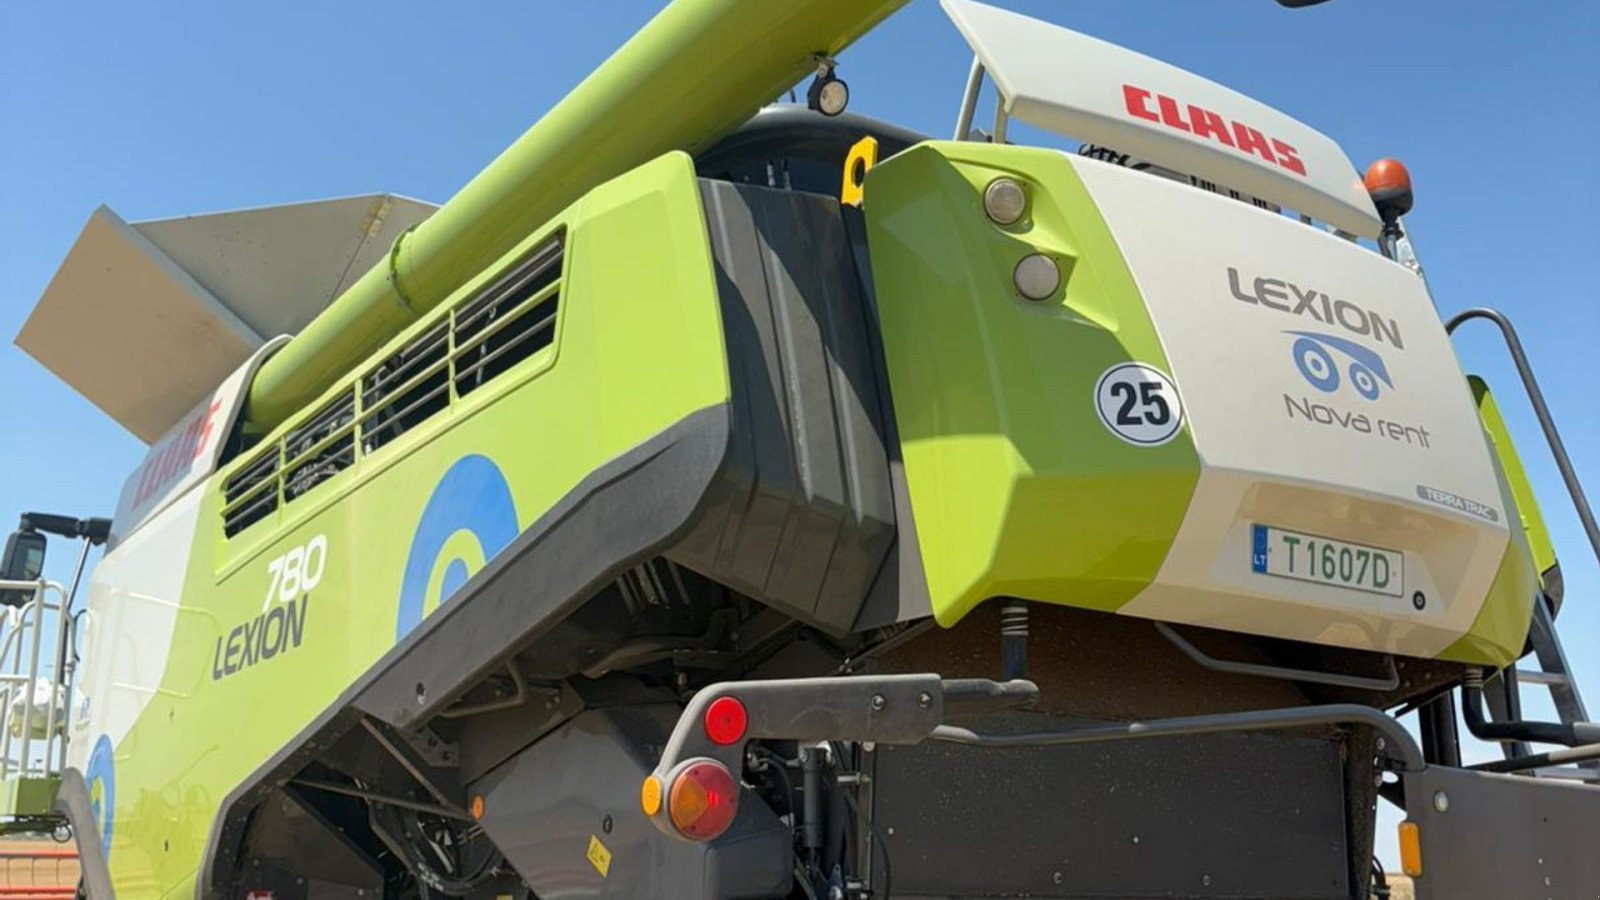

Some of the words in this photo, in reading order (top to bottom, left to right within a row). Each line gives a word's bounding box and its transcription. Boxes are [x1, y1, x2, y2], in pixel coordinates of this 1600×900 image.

[1122, 84, 1307, 176] CLAAS
[1227, 266, 1404, 350] LEXION
[1110, 381, 1170, 426] 25
[1283, 393, 1371, 434] Nova
[1377, 419, 1431, 449] rent
[1424, 487, 1465, 511] TERRA
[261, 533, 327, 614] 780
[1253, 553, 1266, 566] LT
[1283, 535, 1390, 589] T1607D
[212, 593, 309, 681] LEXION
